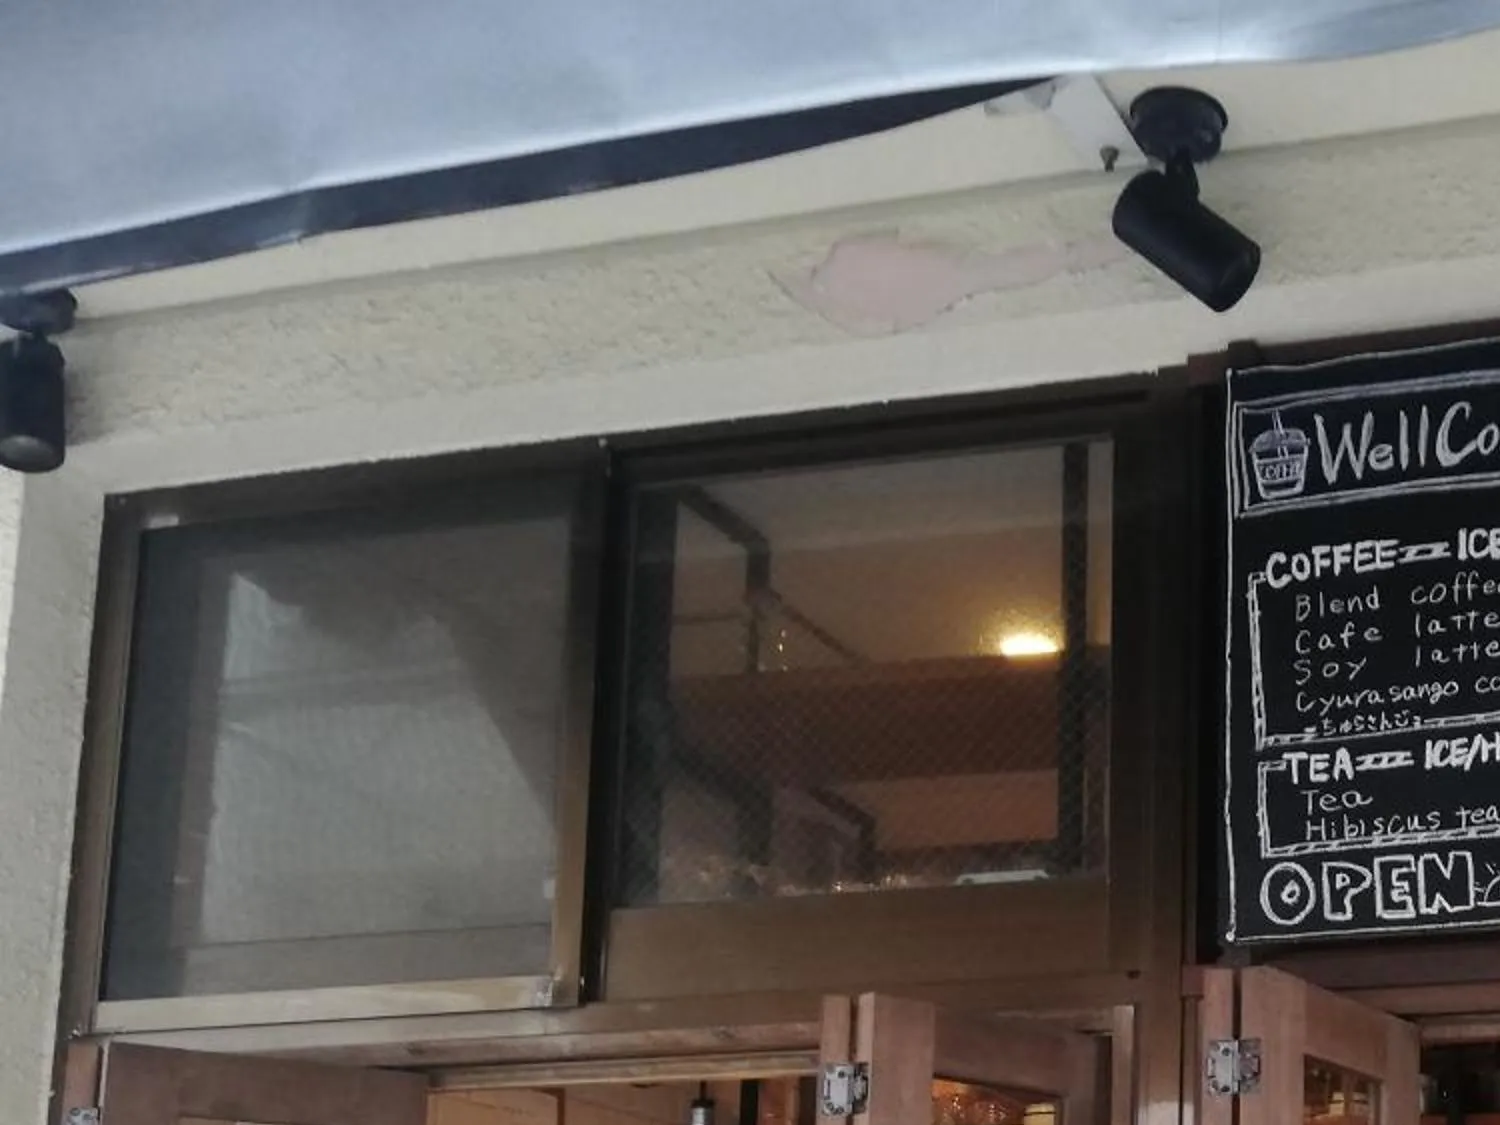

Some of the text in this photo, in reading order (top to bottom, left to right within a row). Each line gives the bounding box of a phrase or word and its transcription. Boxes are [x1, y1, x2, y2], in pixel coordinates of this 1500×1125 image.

[1265, 539, 1399, 589] COFFEE
[1295, 584, 1381, 622] Blend
[1294, 624, 1383, 655] Cafe
[1292, 656, 1368, 687] Soy
[1282, 747, 1356, 785] TEA
[1302, 789, 1374, 816] Tea
[1306, 811, 1442, 842] Hibiscus
[1260, 850, 1476, 926] OPEN
